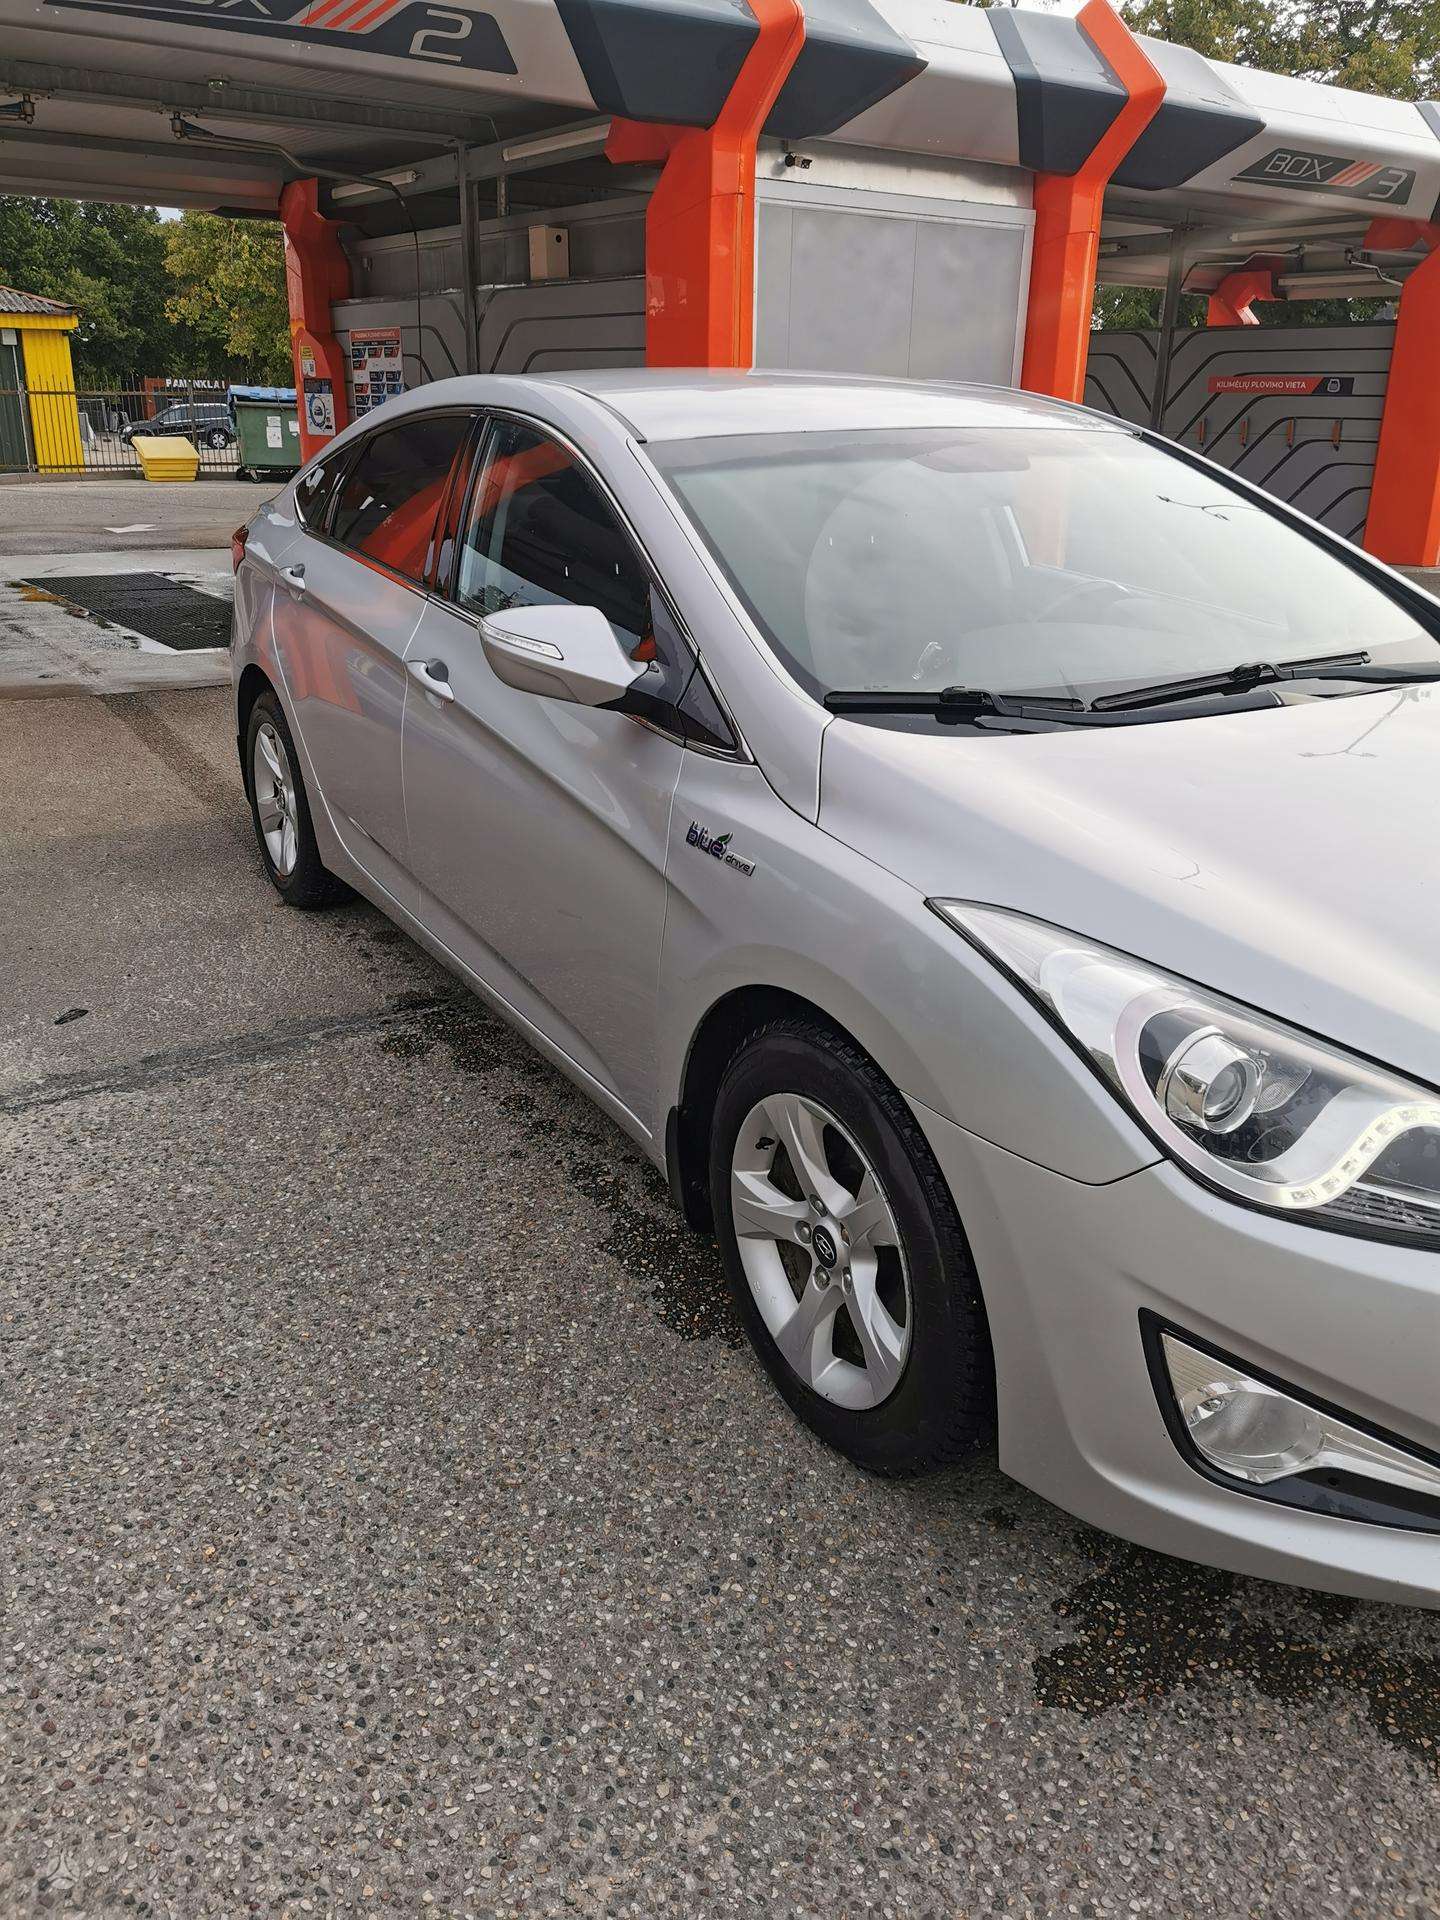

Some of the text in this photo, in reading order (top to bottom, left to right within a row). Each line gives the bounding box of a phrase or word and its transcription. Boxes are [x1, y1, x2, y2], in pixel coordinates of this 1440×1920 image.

[408, 9, 473, 62] 2
[1264, 153, 1409, 198] BOX 3
[1251, 381, 1284, 389] PLOVIMO
[1285, 381, 1307, 389] VIETA
[686, 820, 751, 872] blue drive
